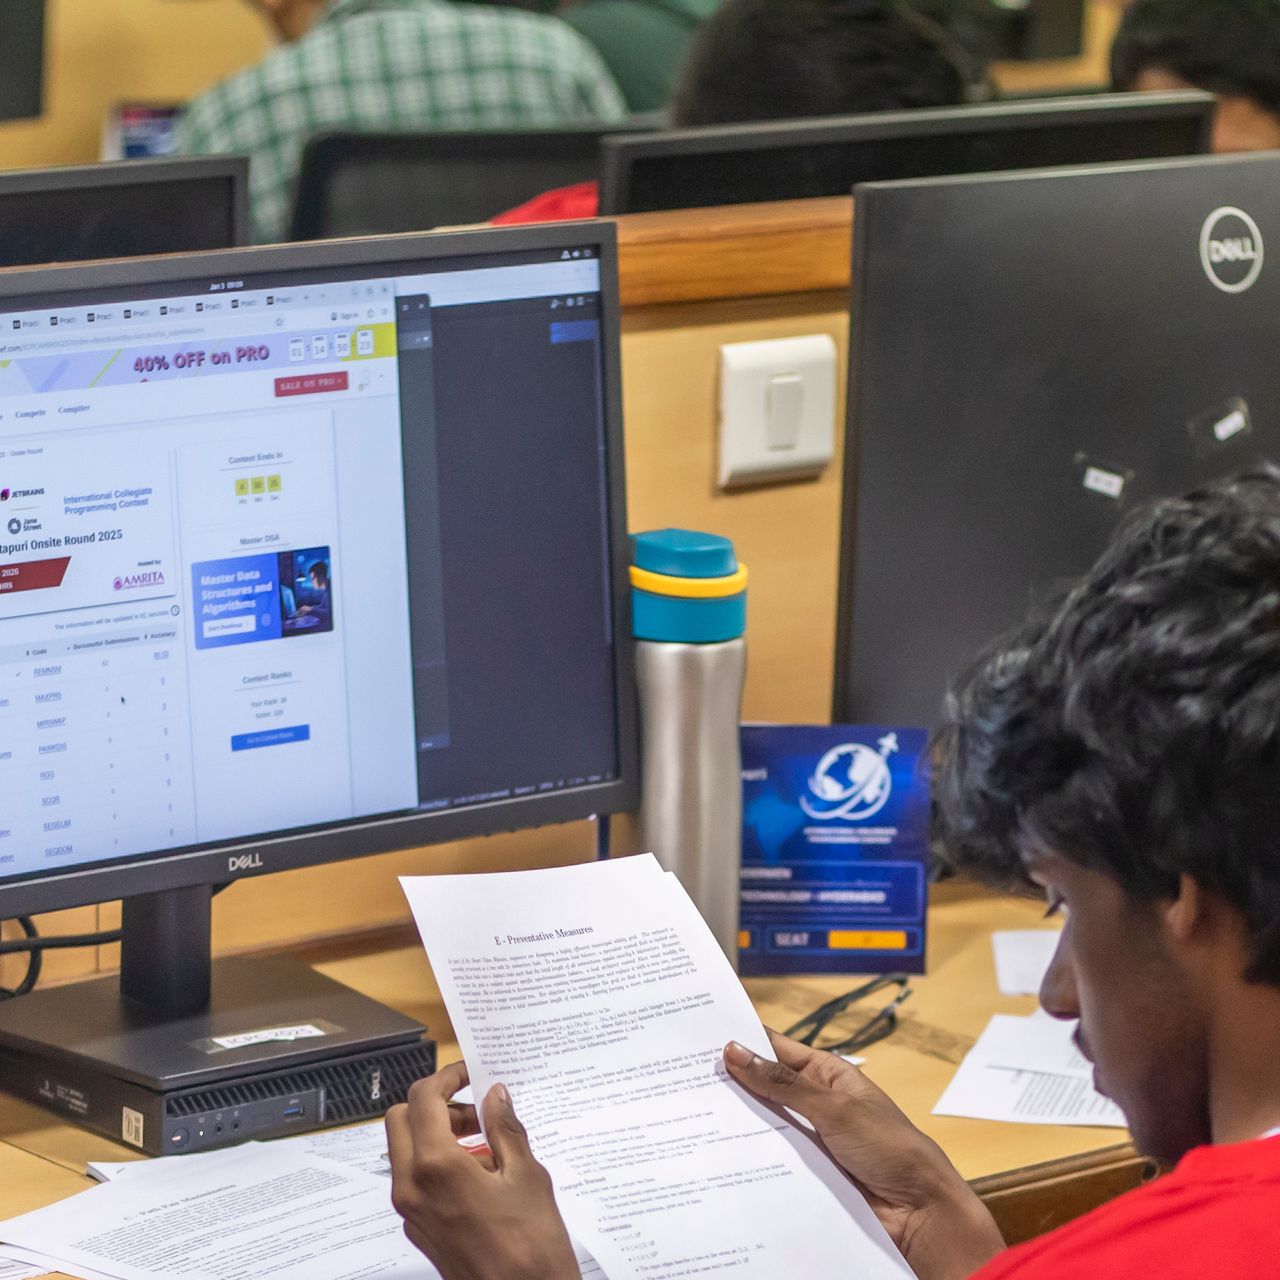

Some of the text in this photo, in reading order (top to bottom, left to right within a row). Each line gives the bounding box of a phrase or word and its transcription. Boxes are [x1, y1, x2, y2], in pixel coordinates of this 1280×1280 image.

[133, 344, 270, 372] 40% OFF on PRO
[15, 408, 46, 419] Compete
[58, 404, 90, 415] Compiler
[10, 488, 44, 498] JETBRAINS
[64, 486, 152, 504] International Collegiate
[64, 498, 148, 516] Programming Contest
[30, 538, 62, 551] Onsite
[64, 534, 95, 546] Round
[98, 530, 123, 540] 2025
[240, 537, 263, 545] Master
[0, 582, 13, 590] HRS
[122, 572, 165, 585] AMRITA
[201, 571, 260, 585] Master Data
[201, 582, 272, 600] Structures and
[202, 599, 256, 615] Algorithms
[228, 853, 263, 872] DELL
[495, 925, 593, 946] E Preventative Measures
[371, 1070, 381, 1100] DELL
